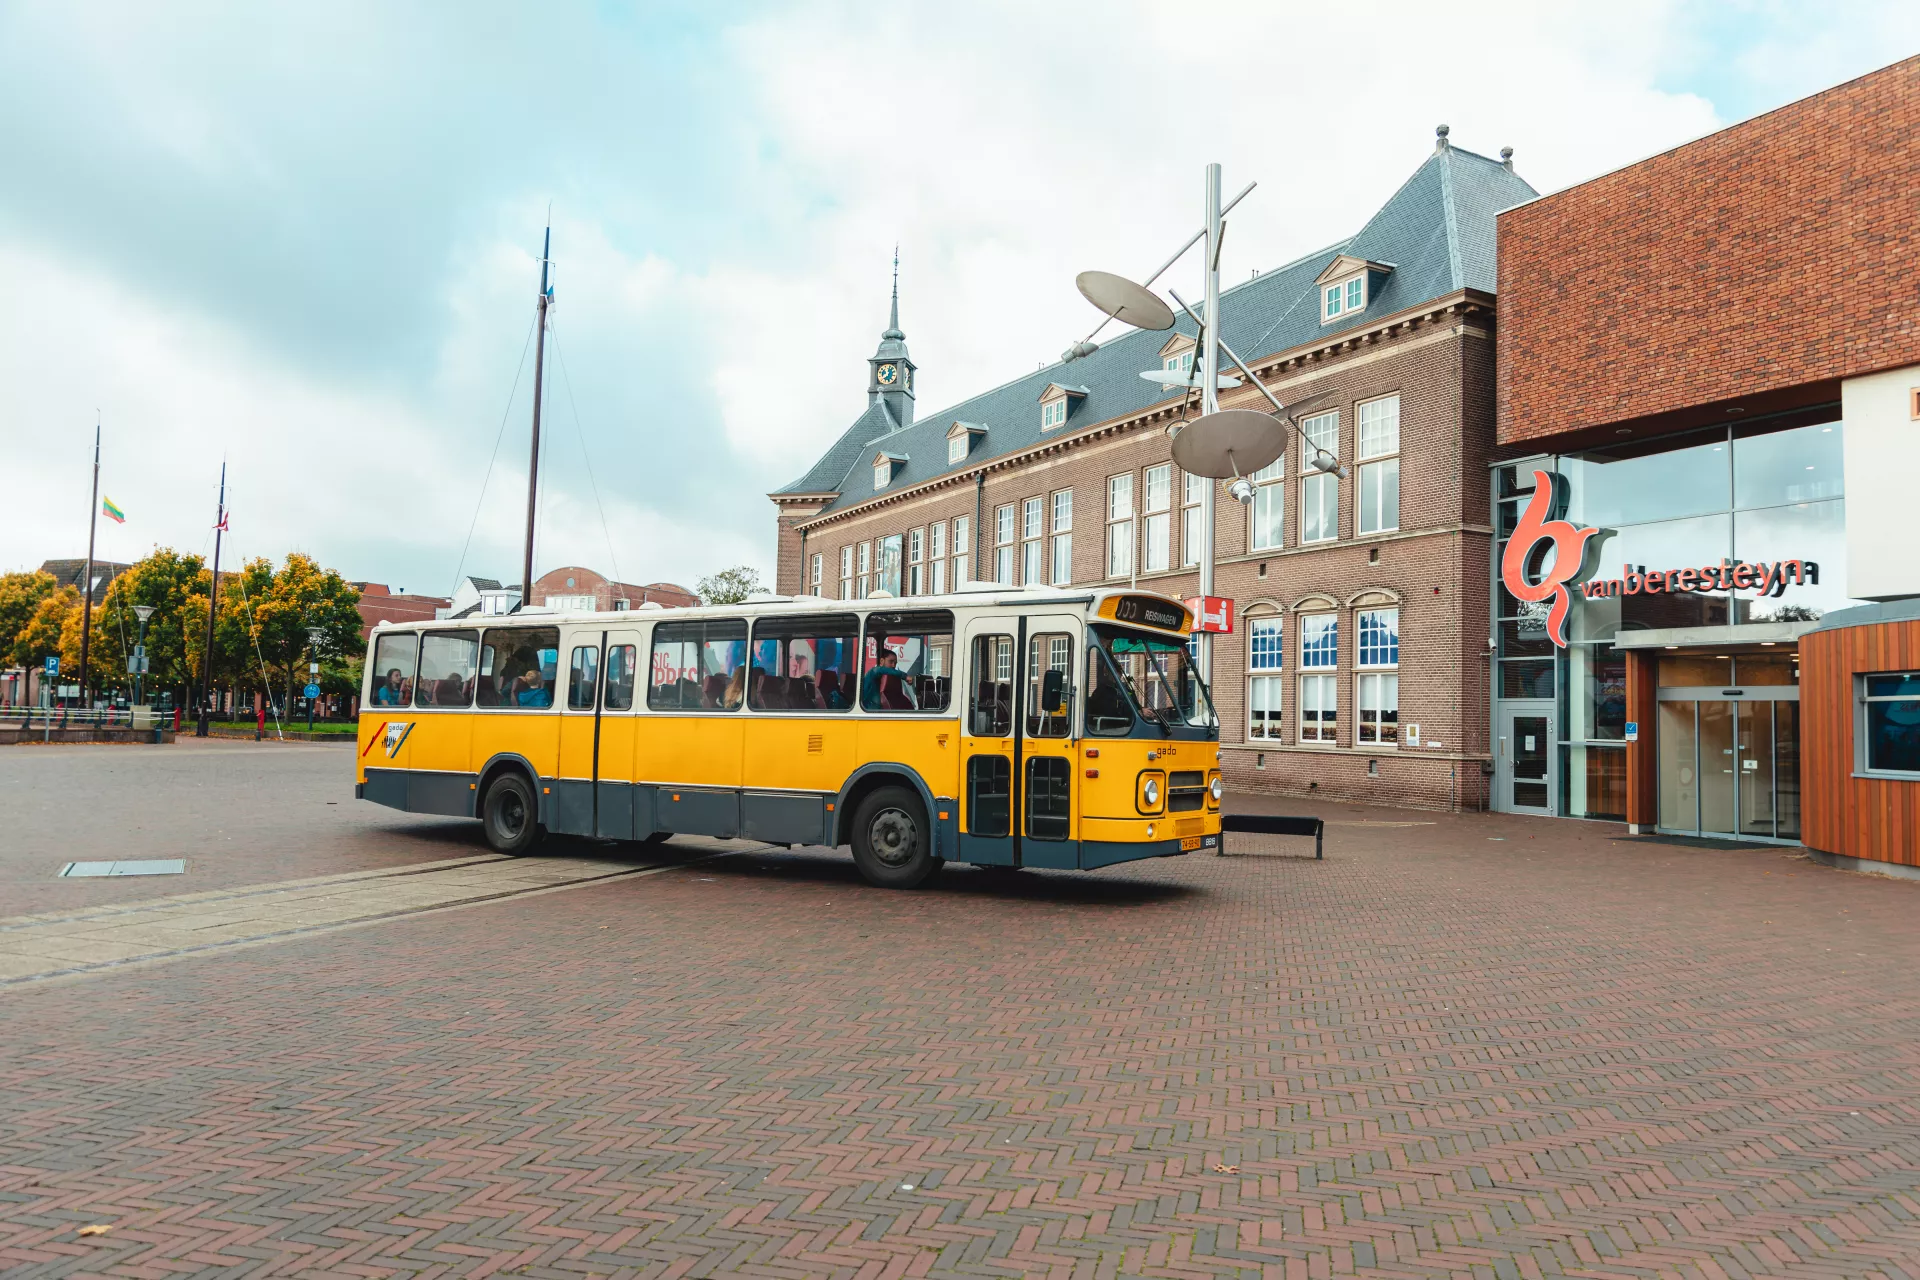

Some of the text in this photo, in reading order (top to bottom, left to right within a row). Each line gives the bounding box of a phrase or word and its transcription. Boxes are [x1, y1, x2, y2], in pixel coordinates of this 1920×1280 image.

[1145, 610, 1176, 625] REISWAGEN
[49, 659, 56, 668] P
[388, 724, 403, 732] gado
[1157, 745, 1177, 759] gado
